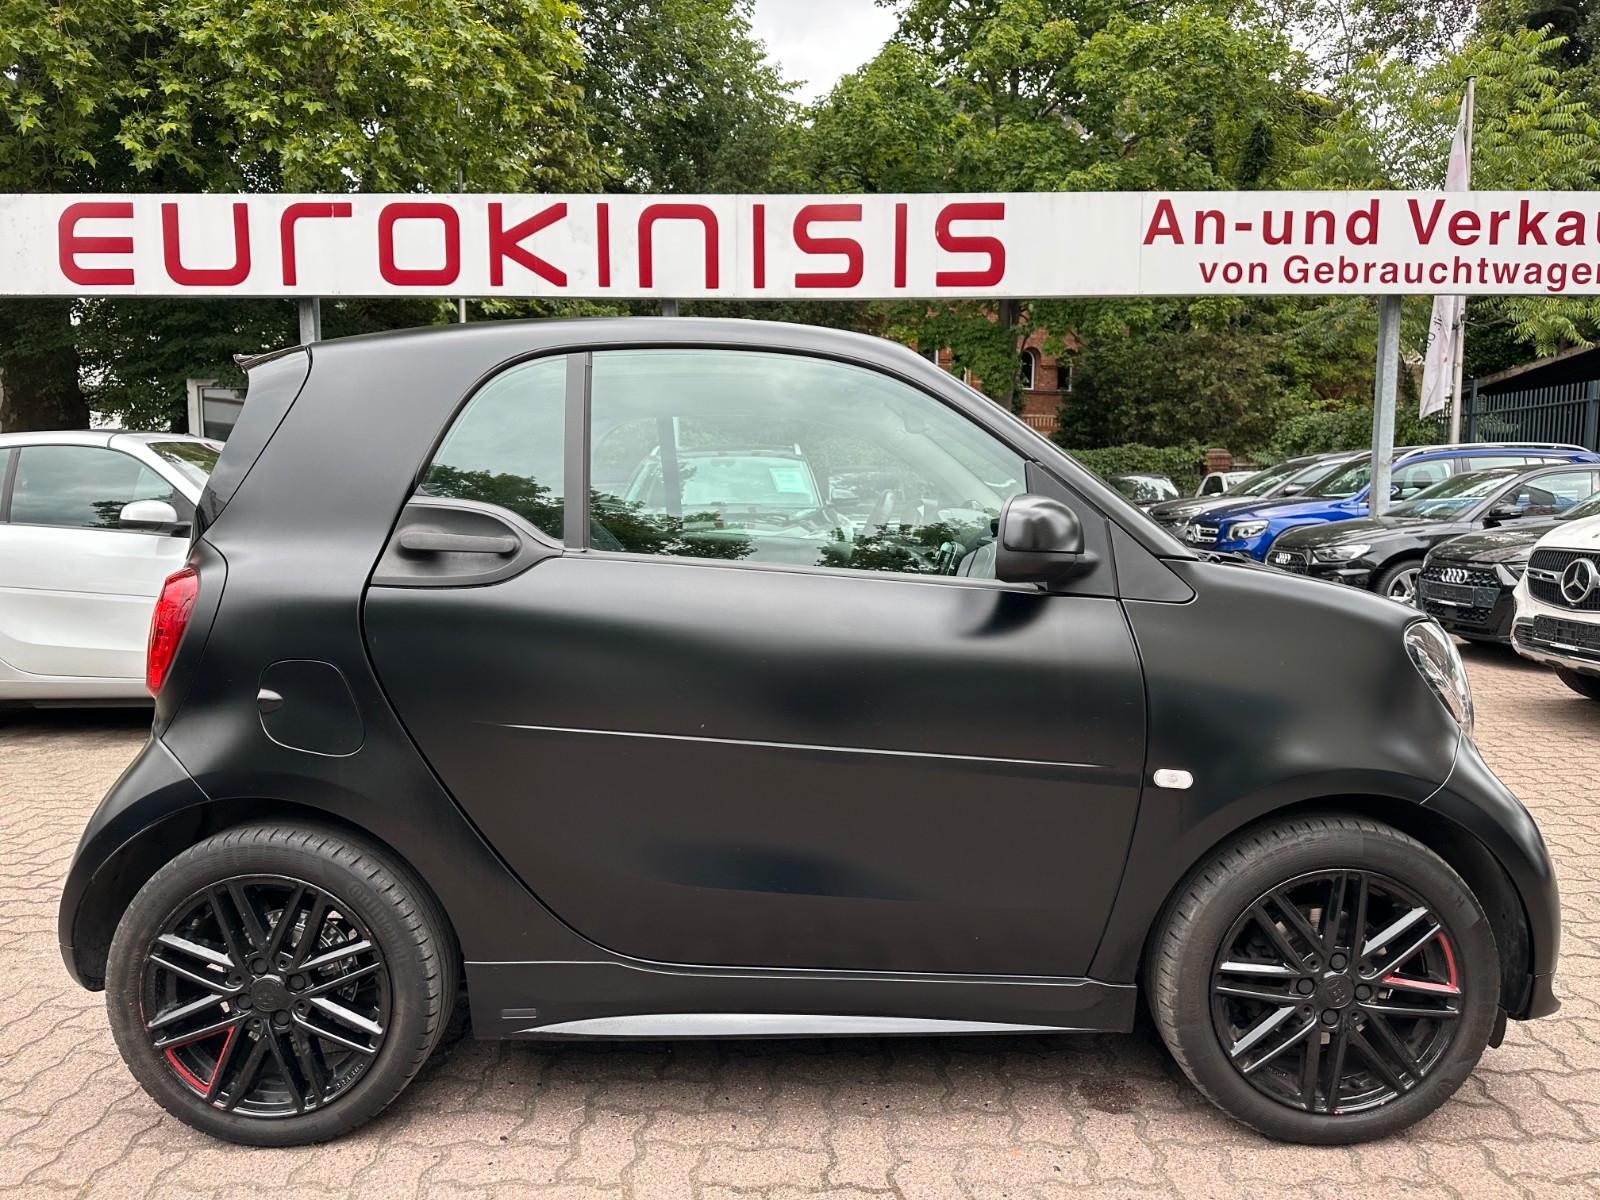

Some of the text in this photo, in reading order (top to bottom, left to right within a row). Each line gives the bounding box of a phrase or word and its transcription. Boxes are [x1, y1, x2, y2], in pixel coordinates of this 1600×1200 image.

[1143, 198, 1600, 246] An-und Verka
[1199, 255, 1600, 293] von Gebrauchtwage
